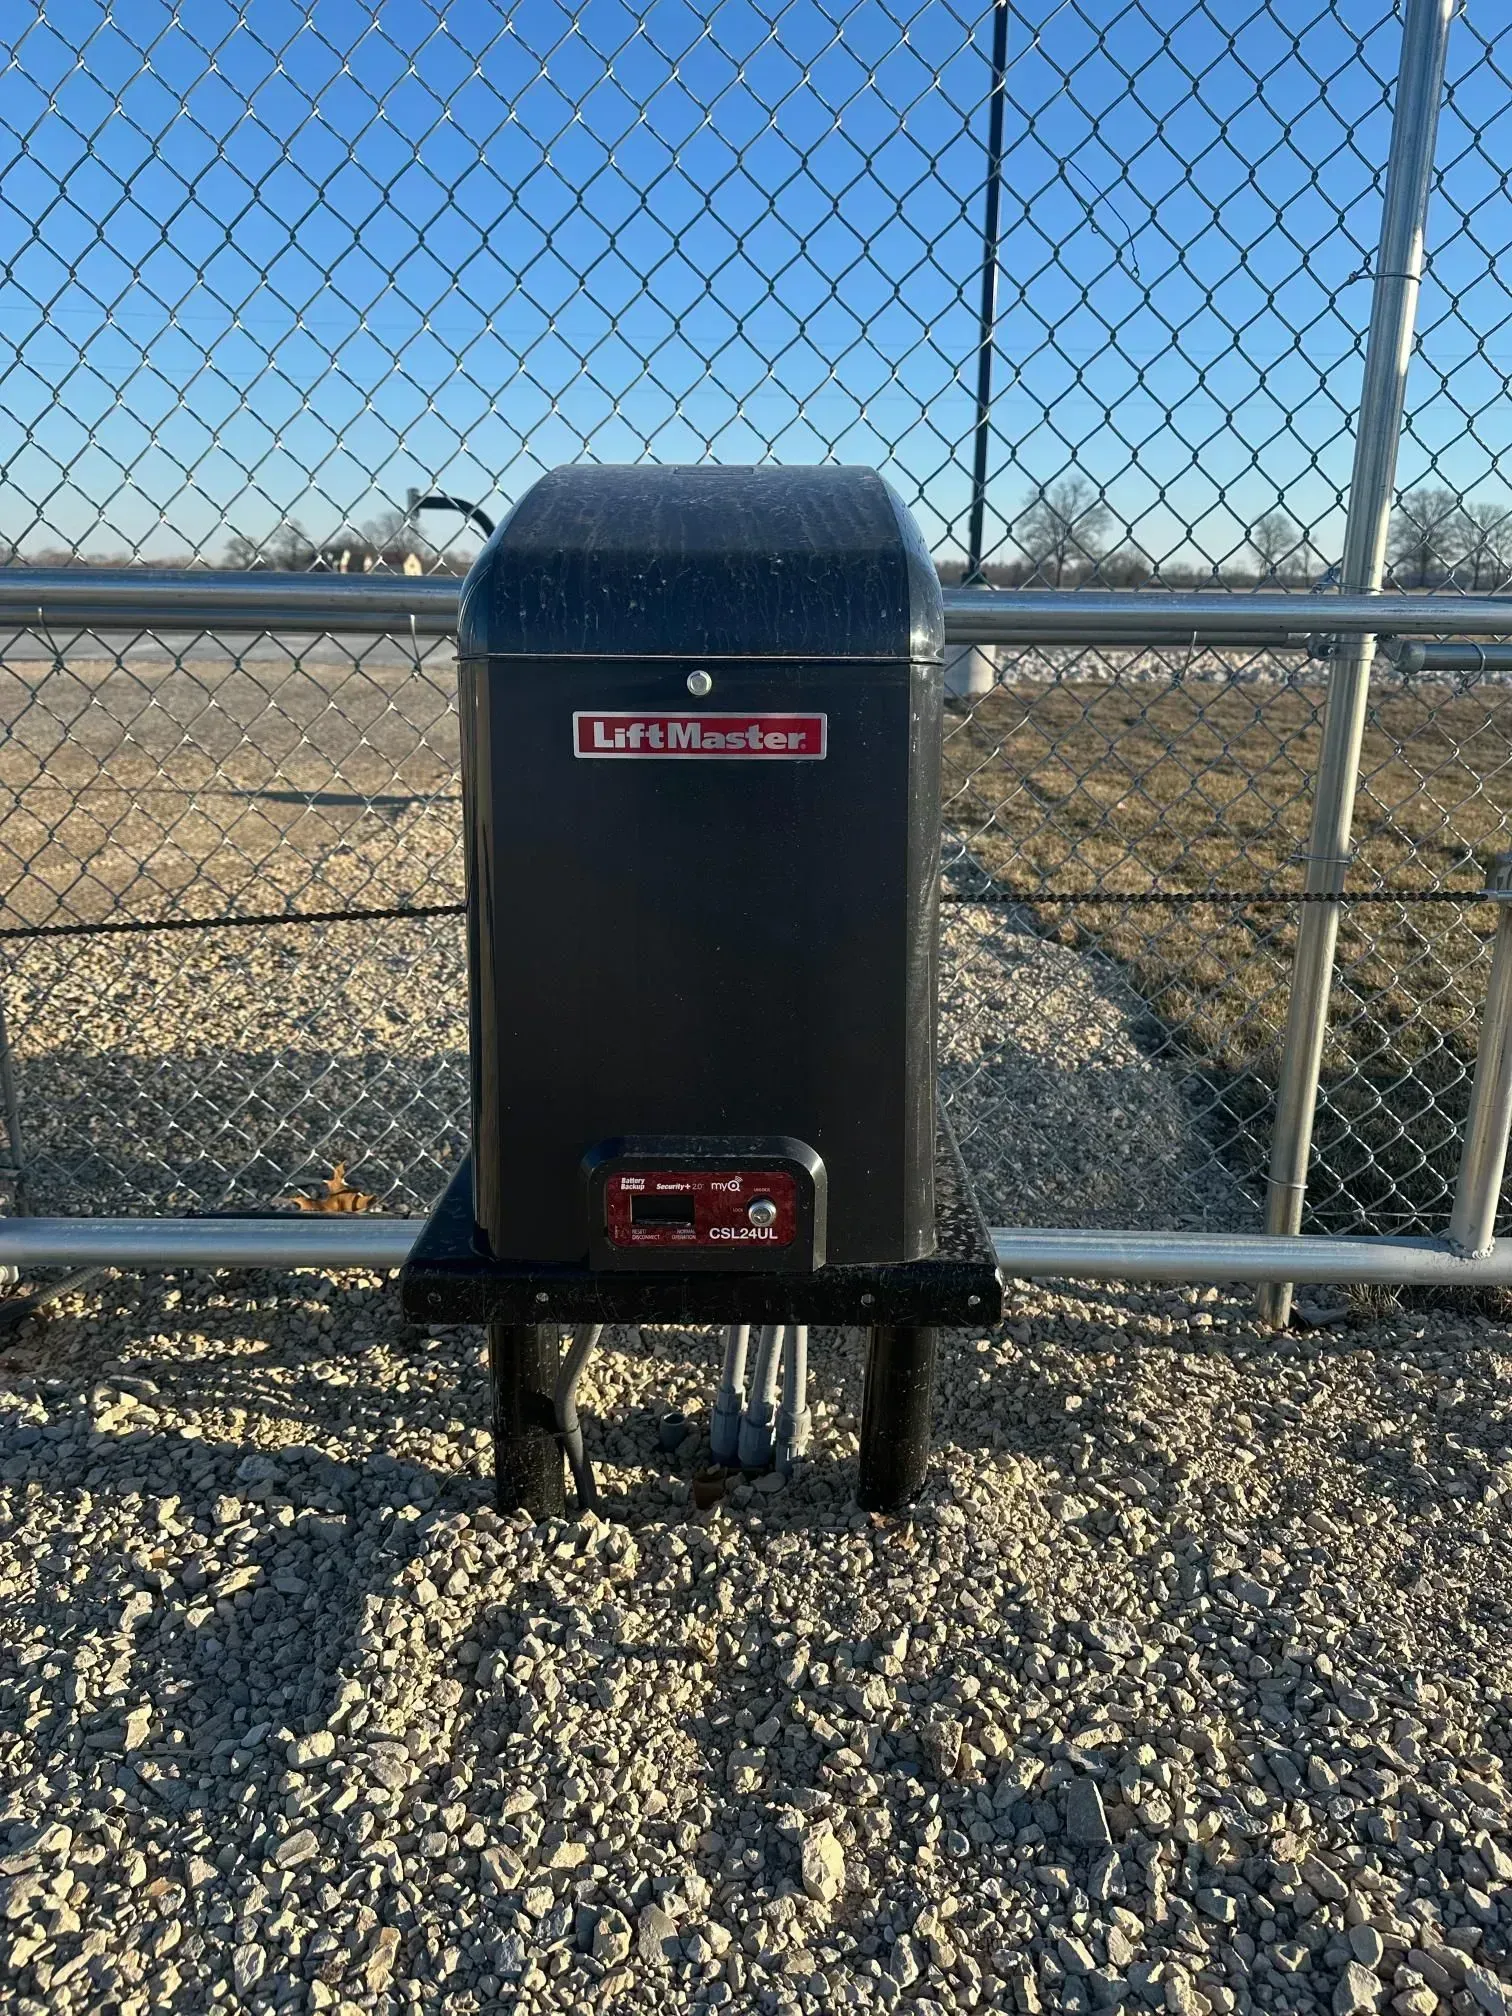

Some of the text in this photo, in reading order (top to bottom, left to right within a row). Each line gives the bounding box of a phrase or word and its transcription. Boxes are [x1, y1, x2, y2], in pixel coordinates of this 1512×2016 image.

[621, 1177, 646, 1185] Battery
[620, 1183, 645, 1191] Backup
[656, 1183, 691, 1191] Security+
[711, 1180, 741, 1192] myQ
[709, 1227, 778, 1240] CSL24UL
